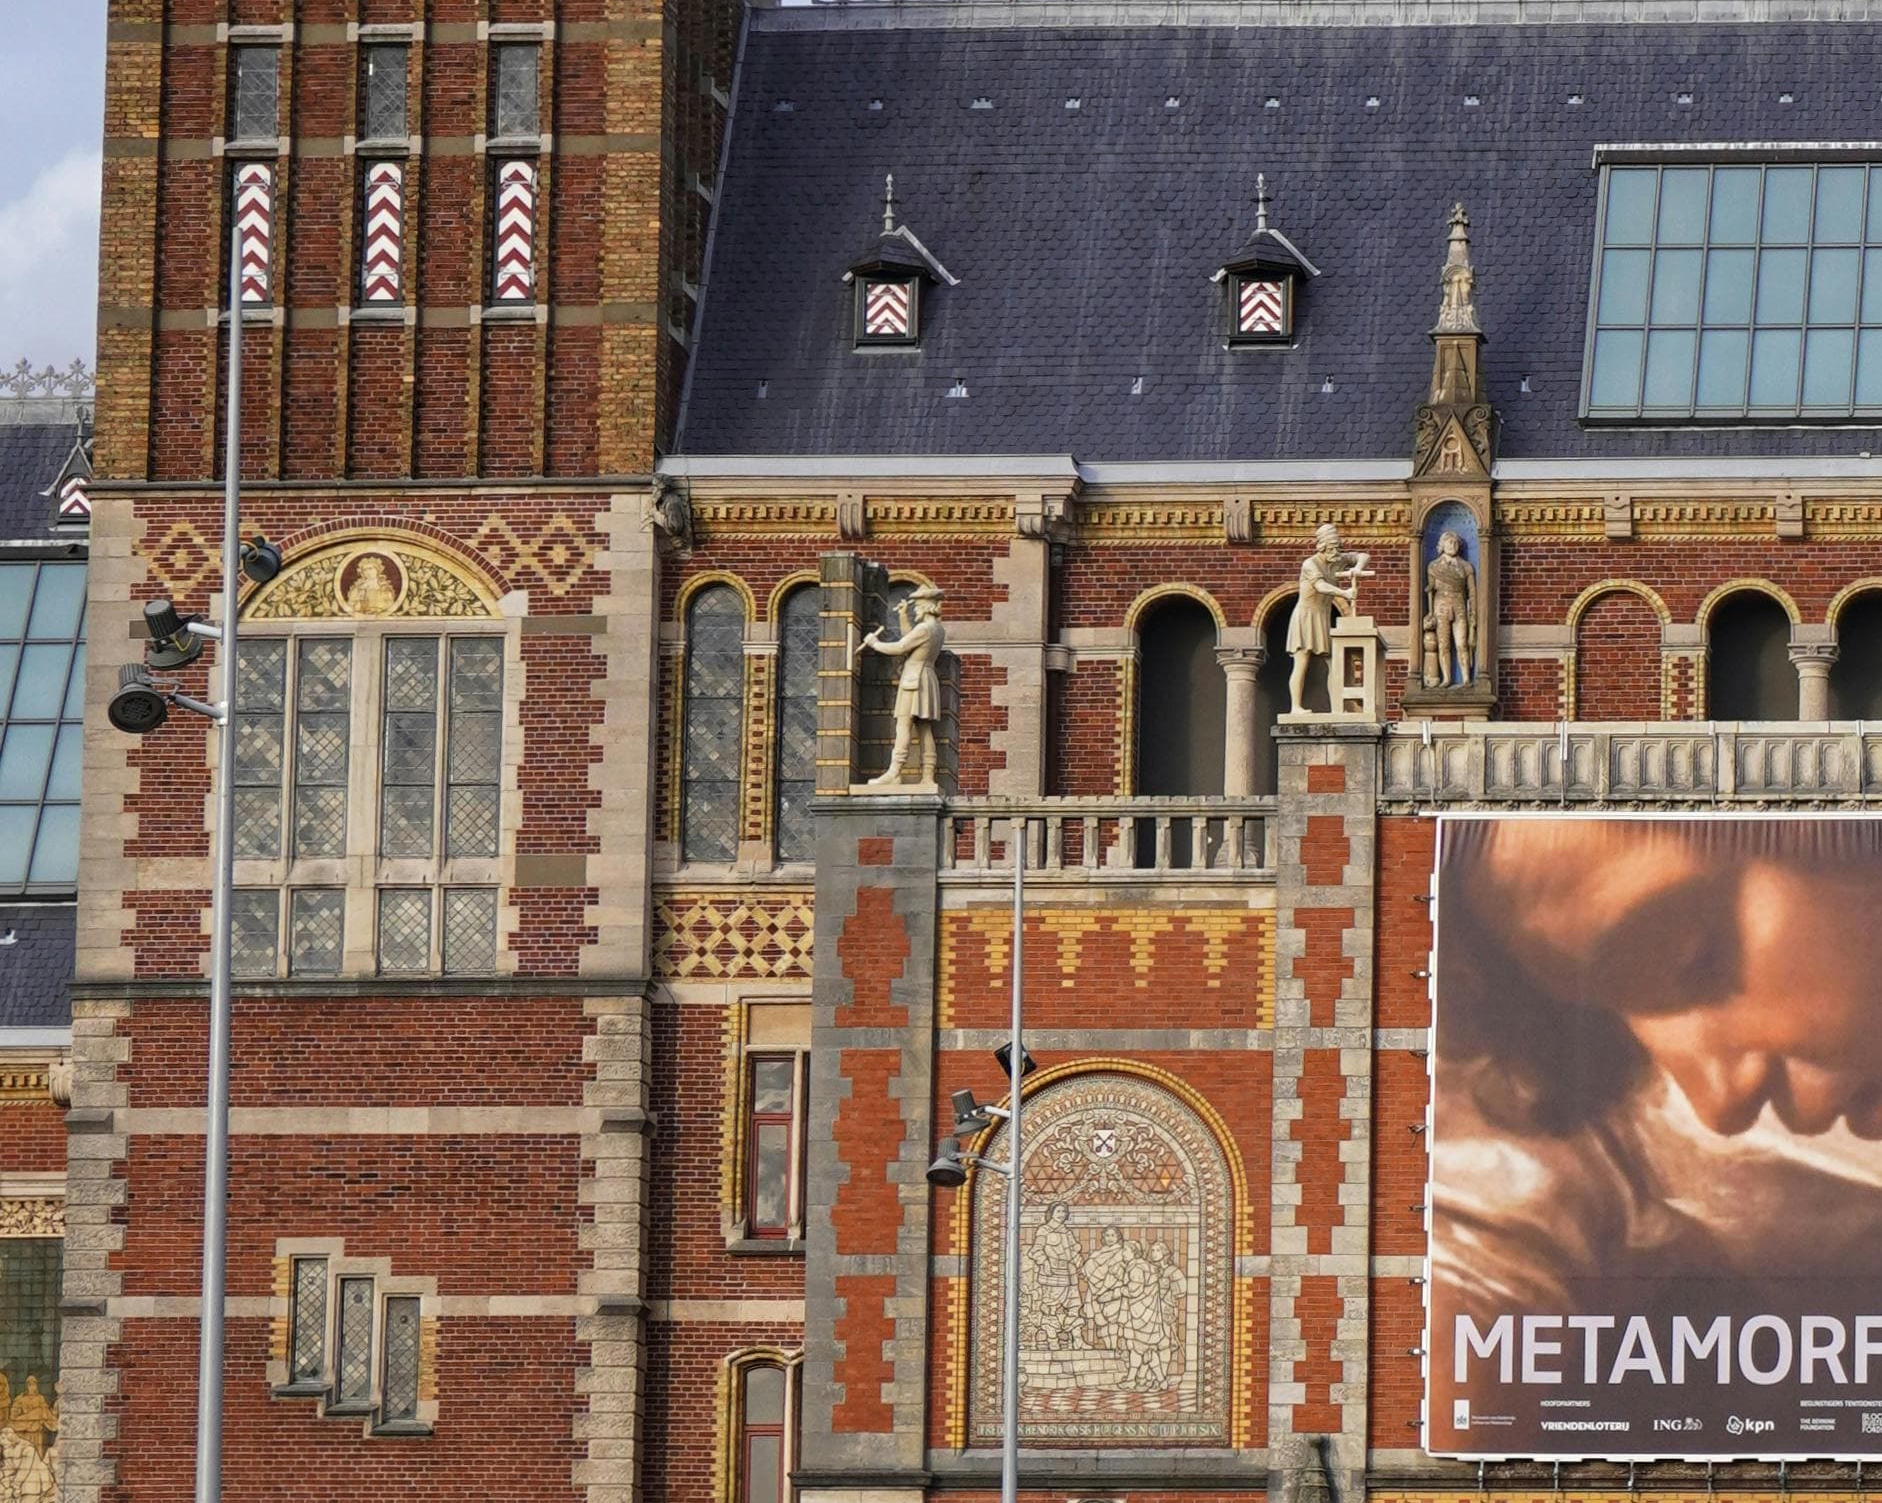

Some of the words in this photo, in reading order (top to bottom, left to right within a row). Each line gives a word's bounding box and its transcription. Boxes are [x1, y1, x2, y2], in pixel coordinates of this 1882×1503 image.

[1540, 1420, 1631, 1432] VRIENDENLOTERIJ
[1653, 1419, 1683, 1431] ING
[1745, 1418, 1776, 1434] kpn
